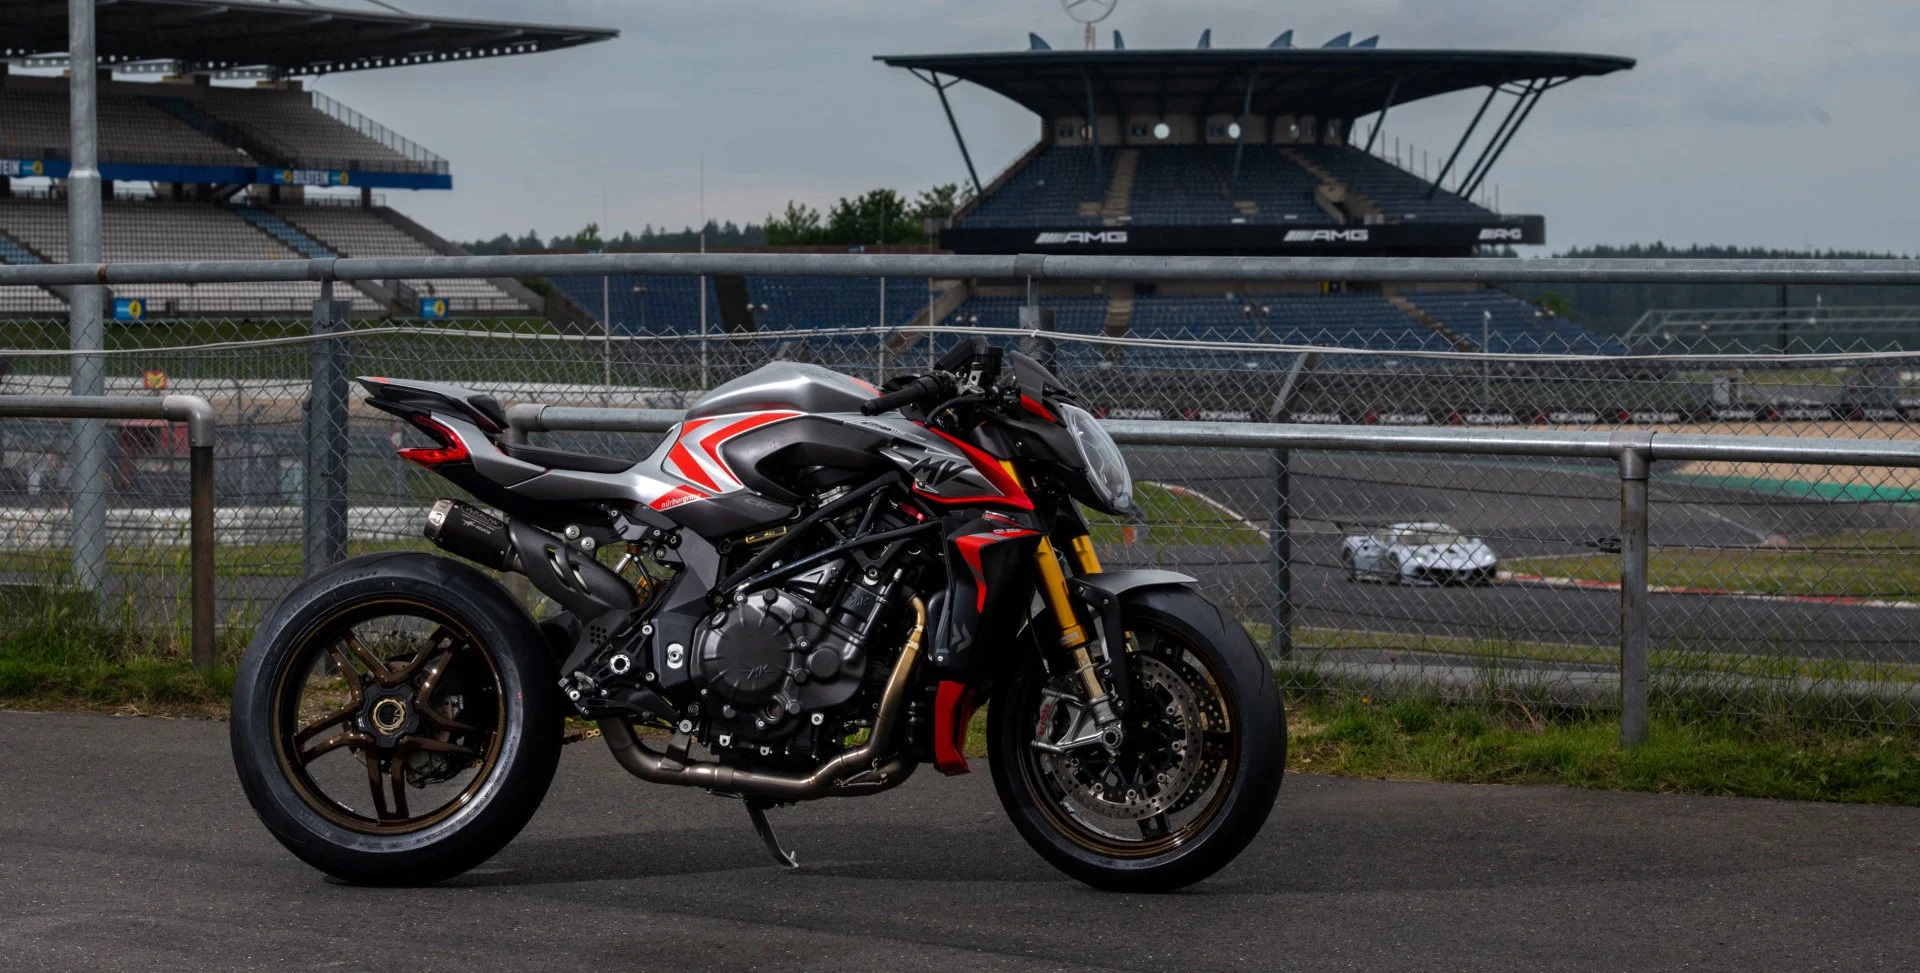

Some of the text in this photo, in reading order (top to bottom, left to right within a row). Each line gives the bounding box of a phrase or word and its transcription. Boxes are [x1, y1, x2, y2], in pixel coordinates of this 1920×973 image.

[1063, 231, 1128, 243] AMG
[1310, 229, 1369, 242] AMG
[909, 456, 974, 488] MV
